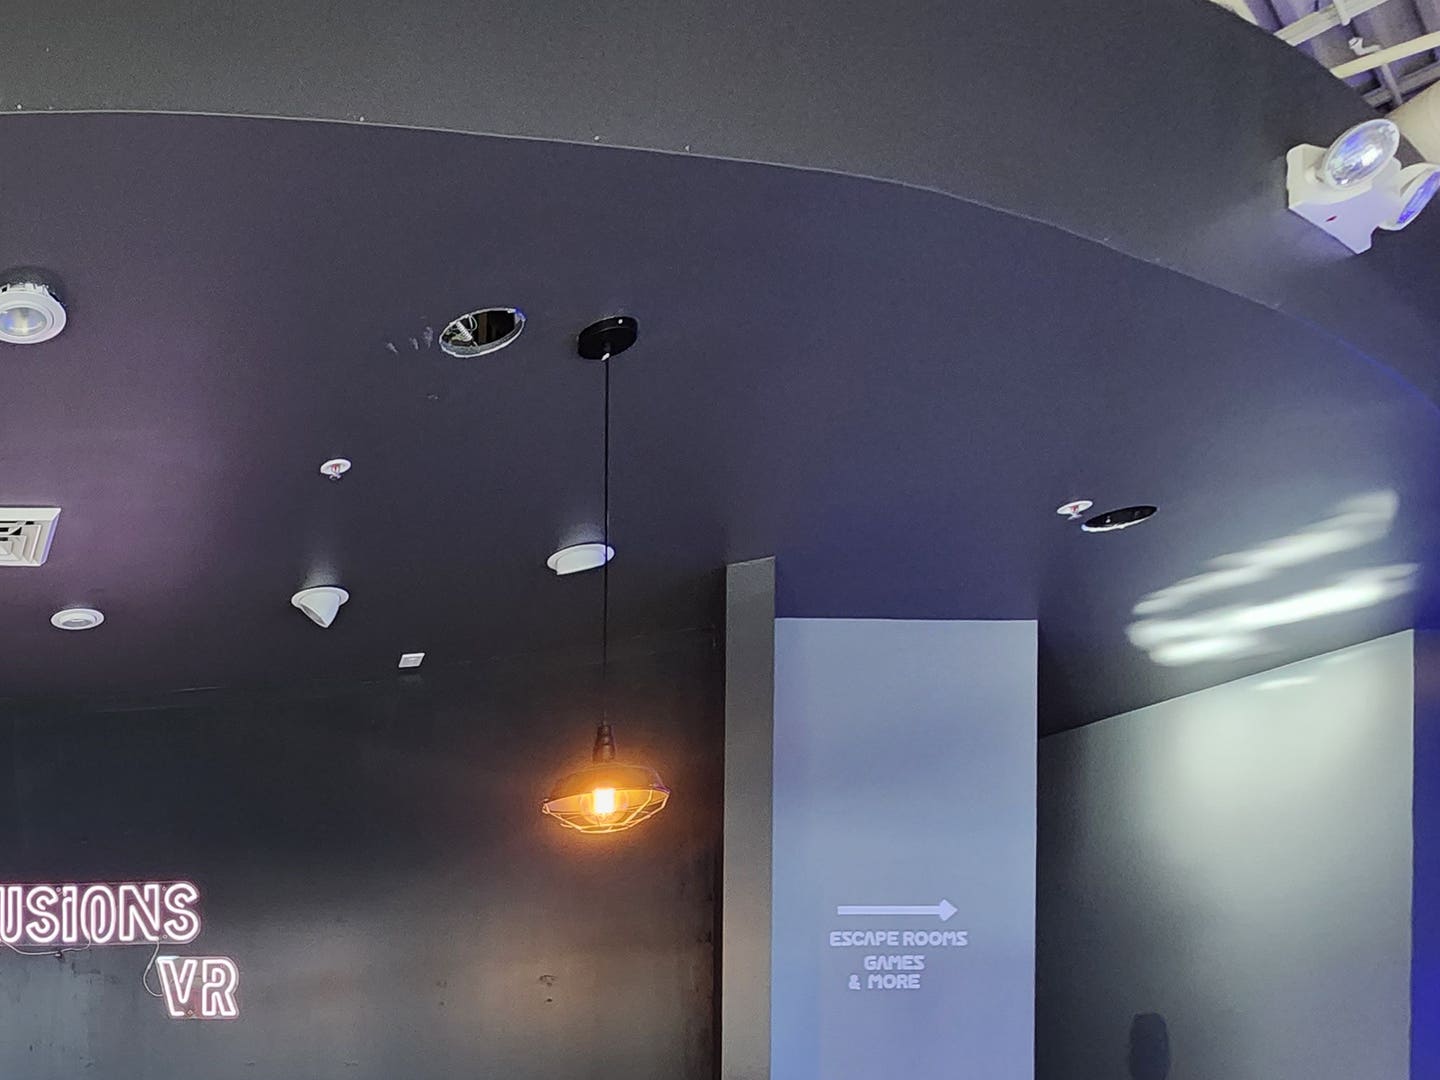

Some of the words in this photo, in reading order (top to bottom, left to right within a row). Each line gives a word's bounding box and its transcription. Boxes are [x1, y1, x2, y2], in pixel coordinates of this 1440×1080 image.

[829, 931, 900, 947] ESCAPE
[902, 930, 969, 946] ROOMS
[864, 955, 926, 971] GAMES
[157, 957, 240, 1017] VR
[848, 974, 861, 990] &
[867, 974, 921, 989] MORE
